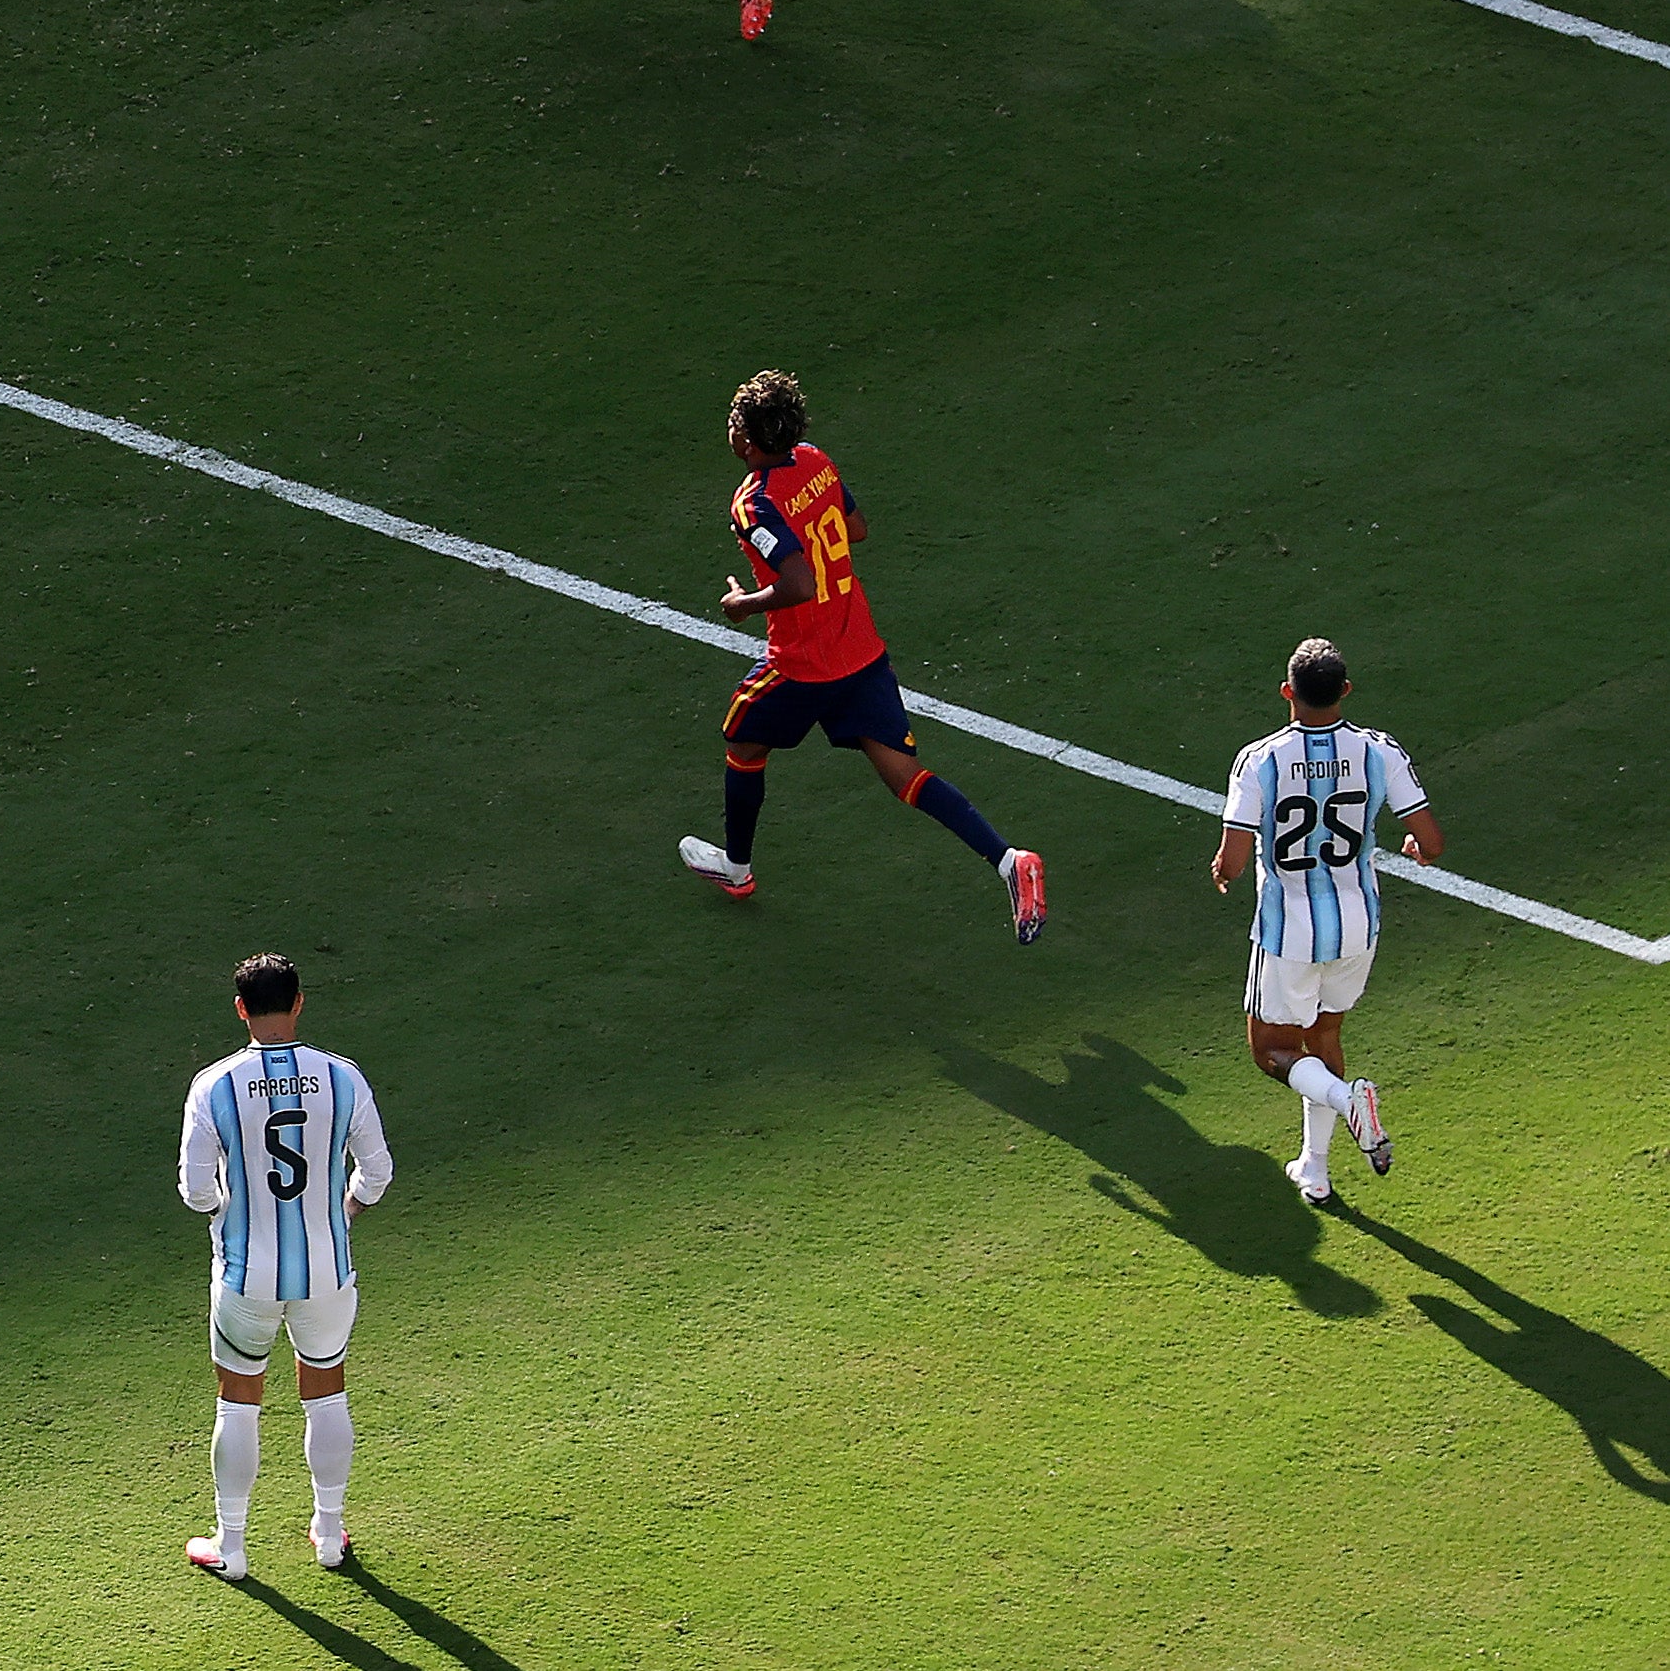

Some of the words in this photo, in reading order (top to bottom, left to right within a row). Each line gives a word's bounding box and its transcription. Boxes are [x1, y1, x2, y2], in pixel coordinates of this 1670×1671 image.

[804, 504, 853, 604] 19
[1291, 759, 1351, 781] MEDINA
[1274, 790, 1368, 872] 25
[248, 1075, 320, 1099] PAREDES
[264, 1109, 308, 1202] 5
